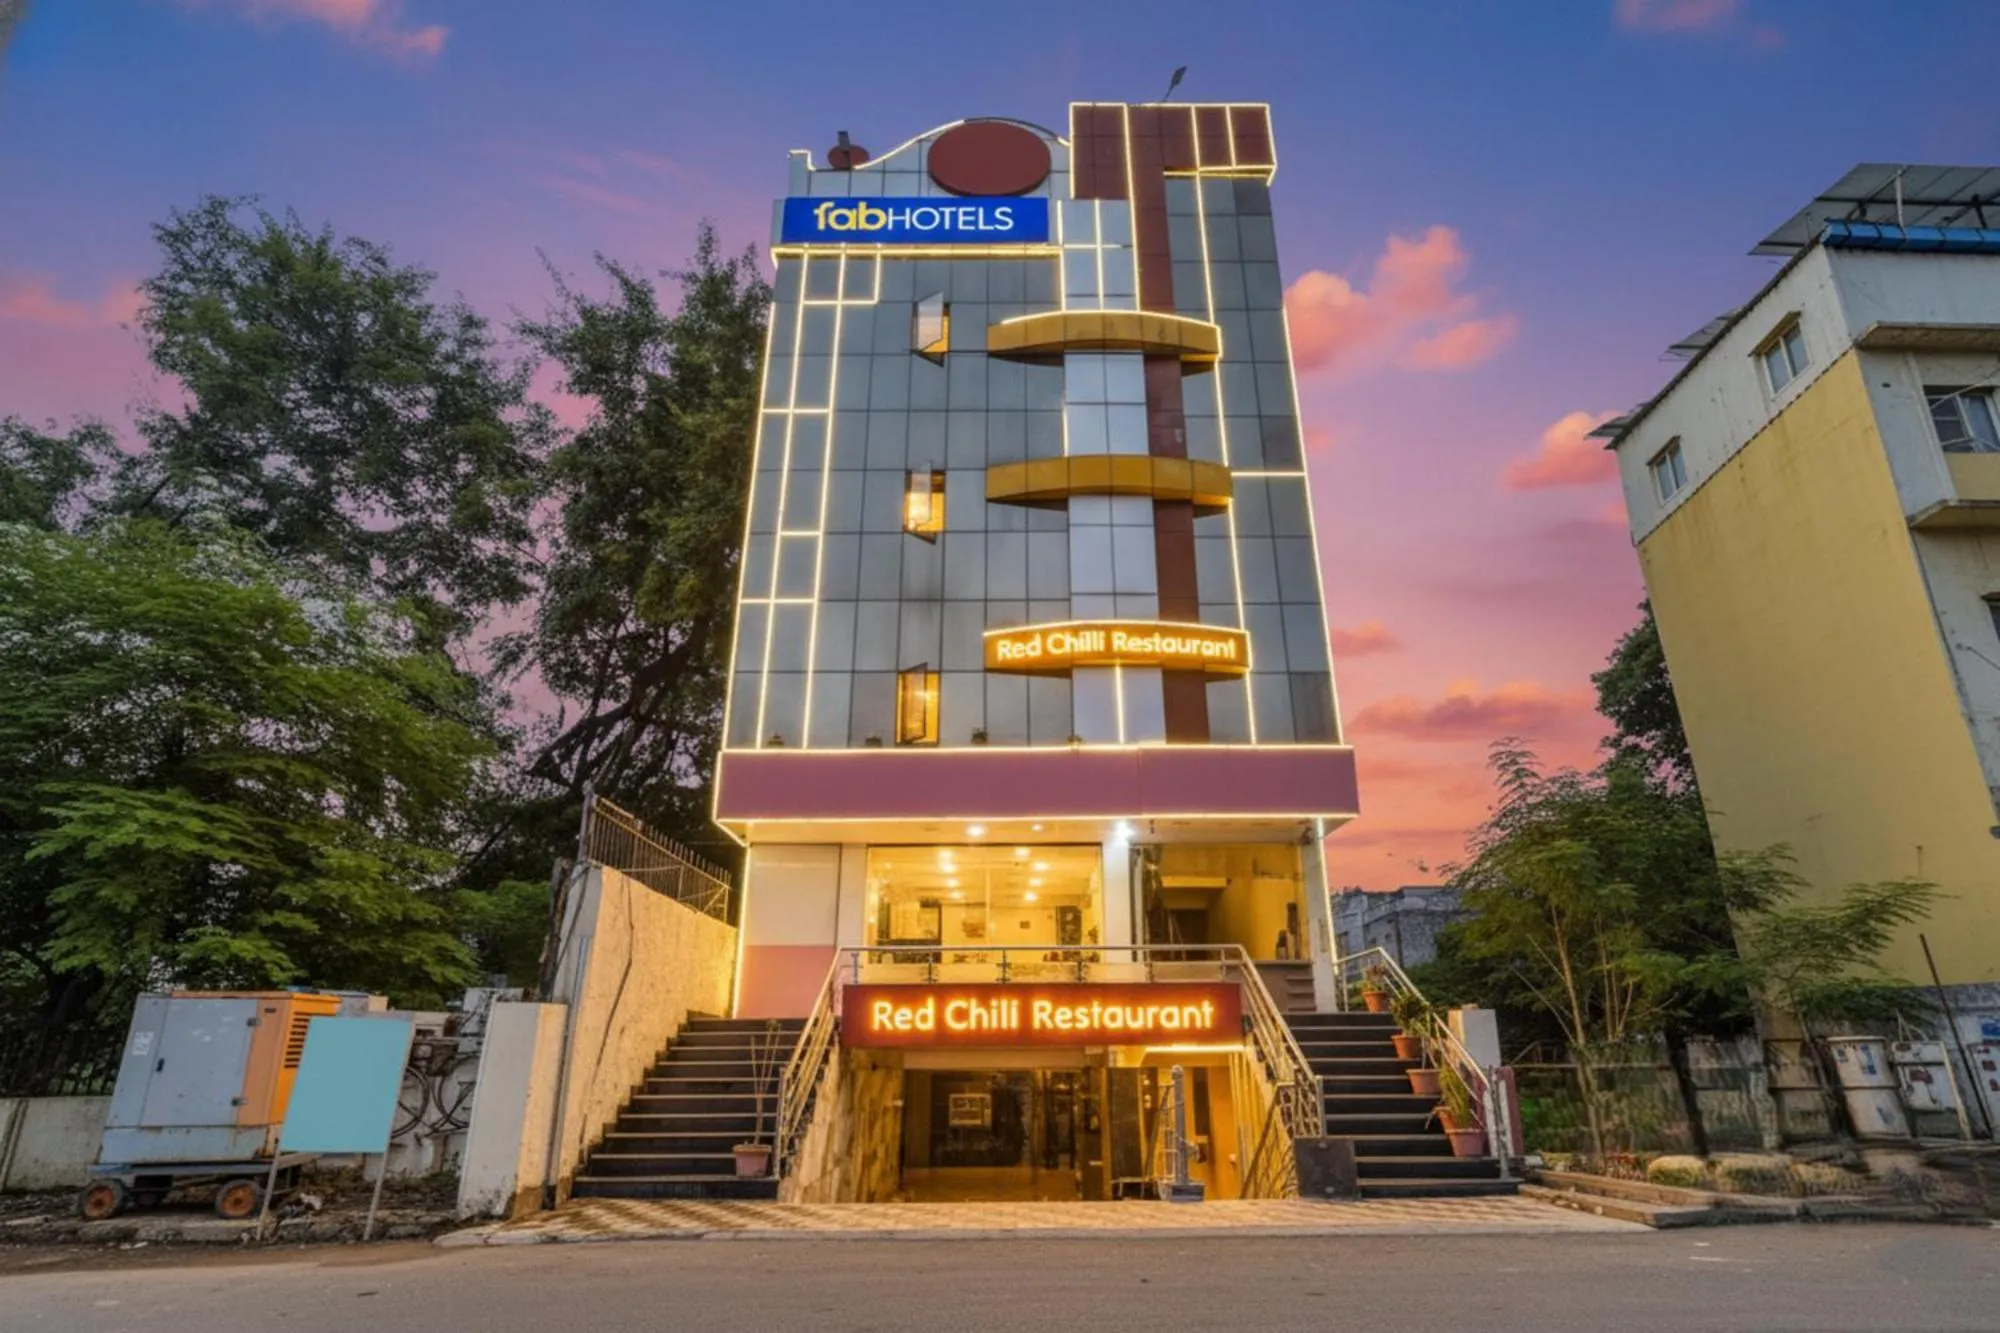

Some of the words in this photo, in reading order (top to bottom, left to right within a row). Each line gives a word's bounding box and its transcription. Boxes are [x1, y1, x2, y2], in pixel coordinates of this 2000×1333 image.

[814, 201, 1015, 231] fabHOTELS
[996, 633, 1041, 660] Red
[1111, 631, 1236, 659] Restaurant
[872, 997, 934, 1031] Red
[944, 997, 1020, 1031] Chili
[1032, 1000, 1214, 1030] Restaurant
